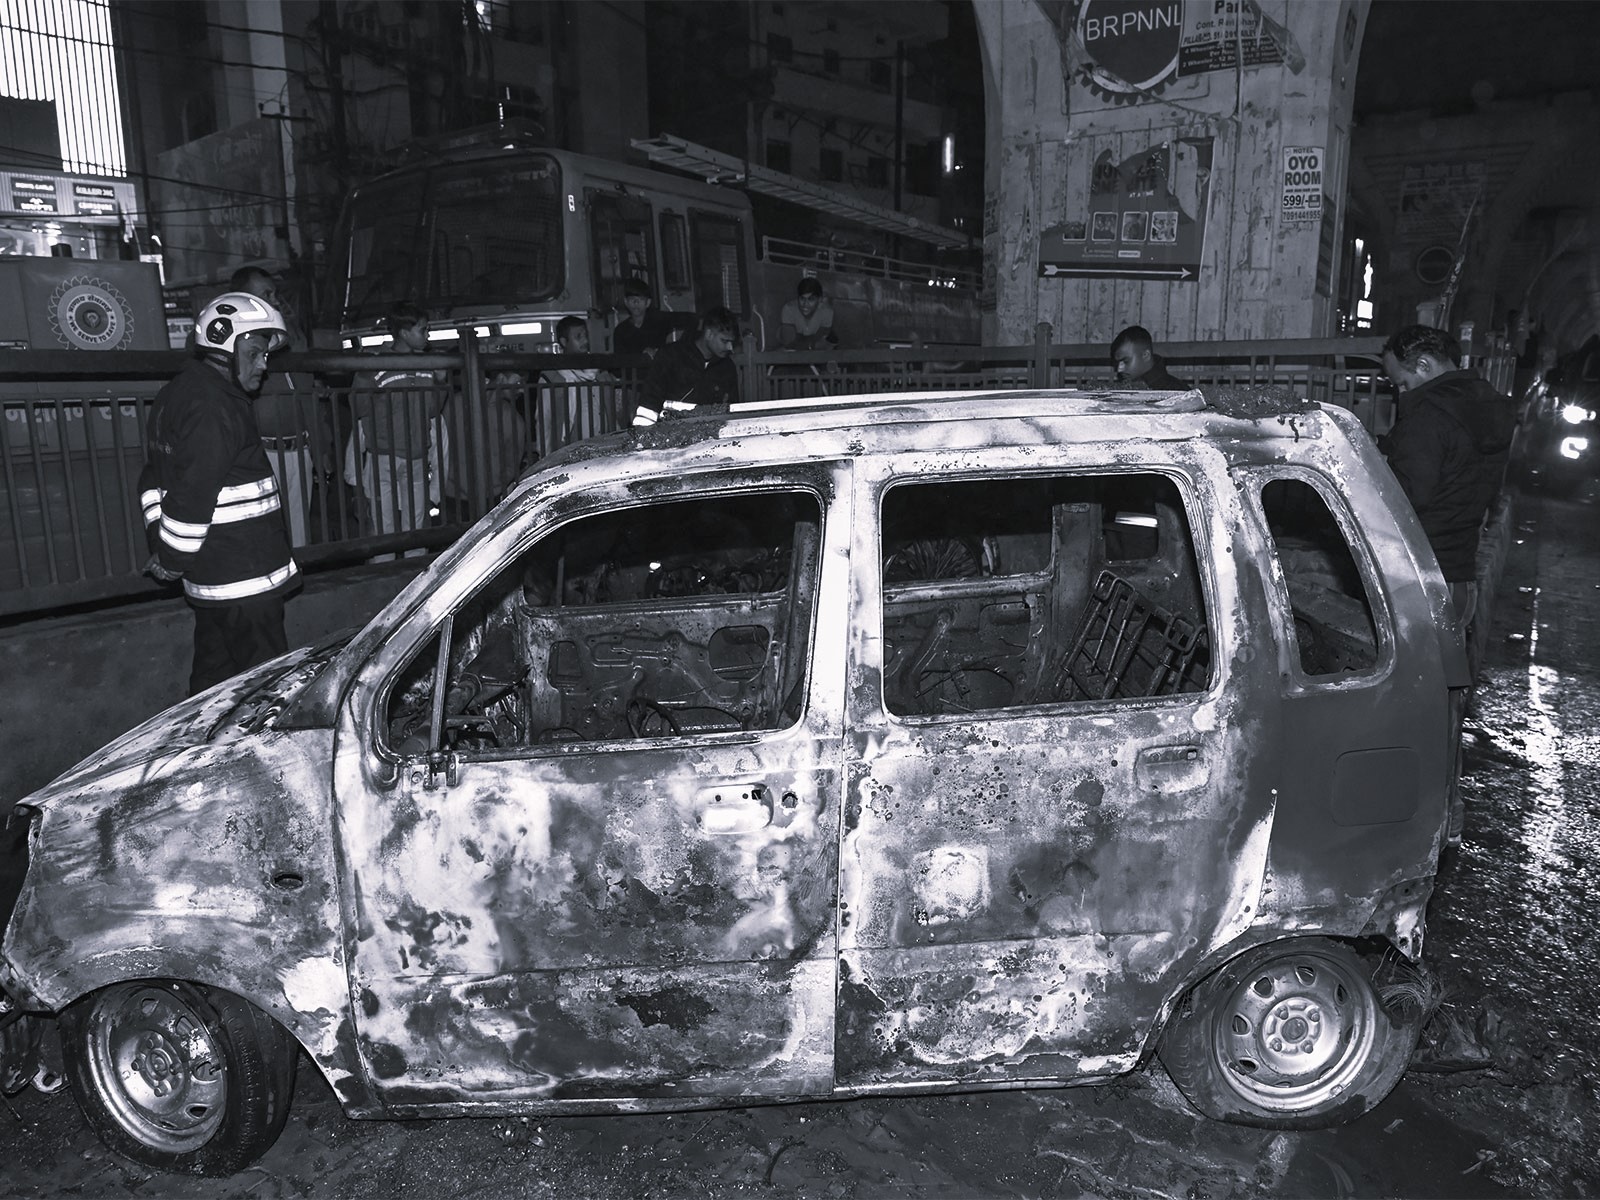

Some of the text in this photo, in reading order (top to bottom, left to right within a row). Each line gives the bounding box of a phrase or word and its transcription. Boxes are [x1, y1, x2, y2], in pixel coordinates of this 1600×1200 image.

[1086, 4, 1181, 41] BRPNNL
[1288, 155, 1318, 170] OYO
[1284, 171, 1321, 186] ROOM
[1283, 194, 1309, 207] 599/-
